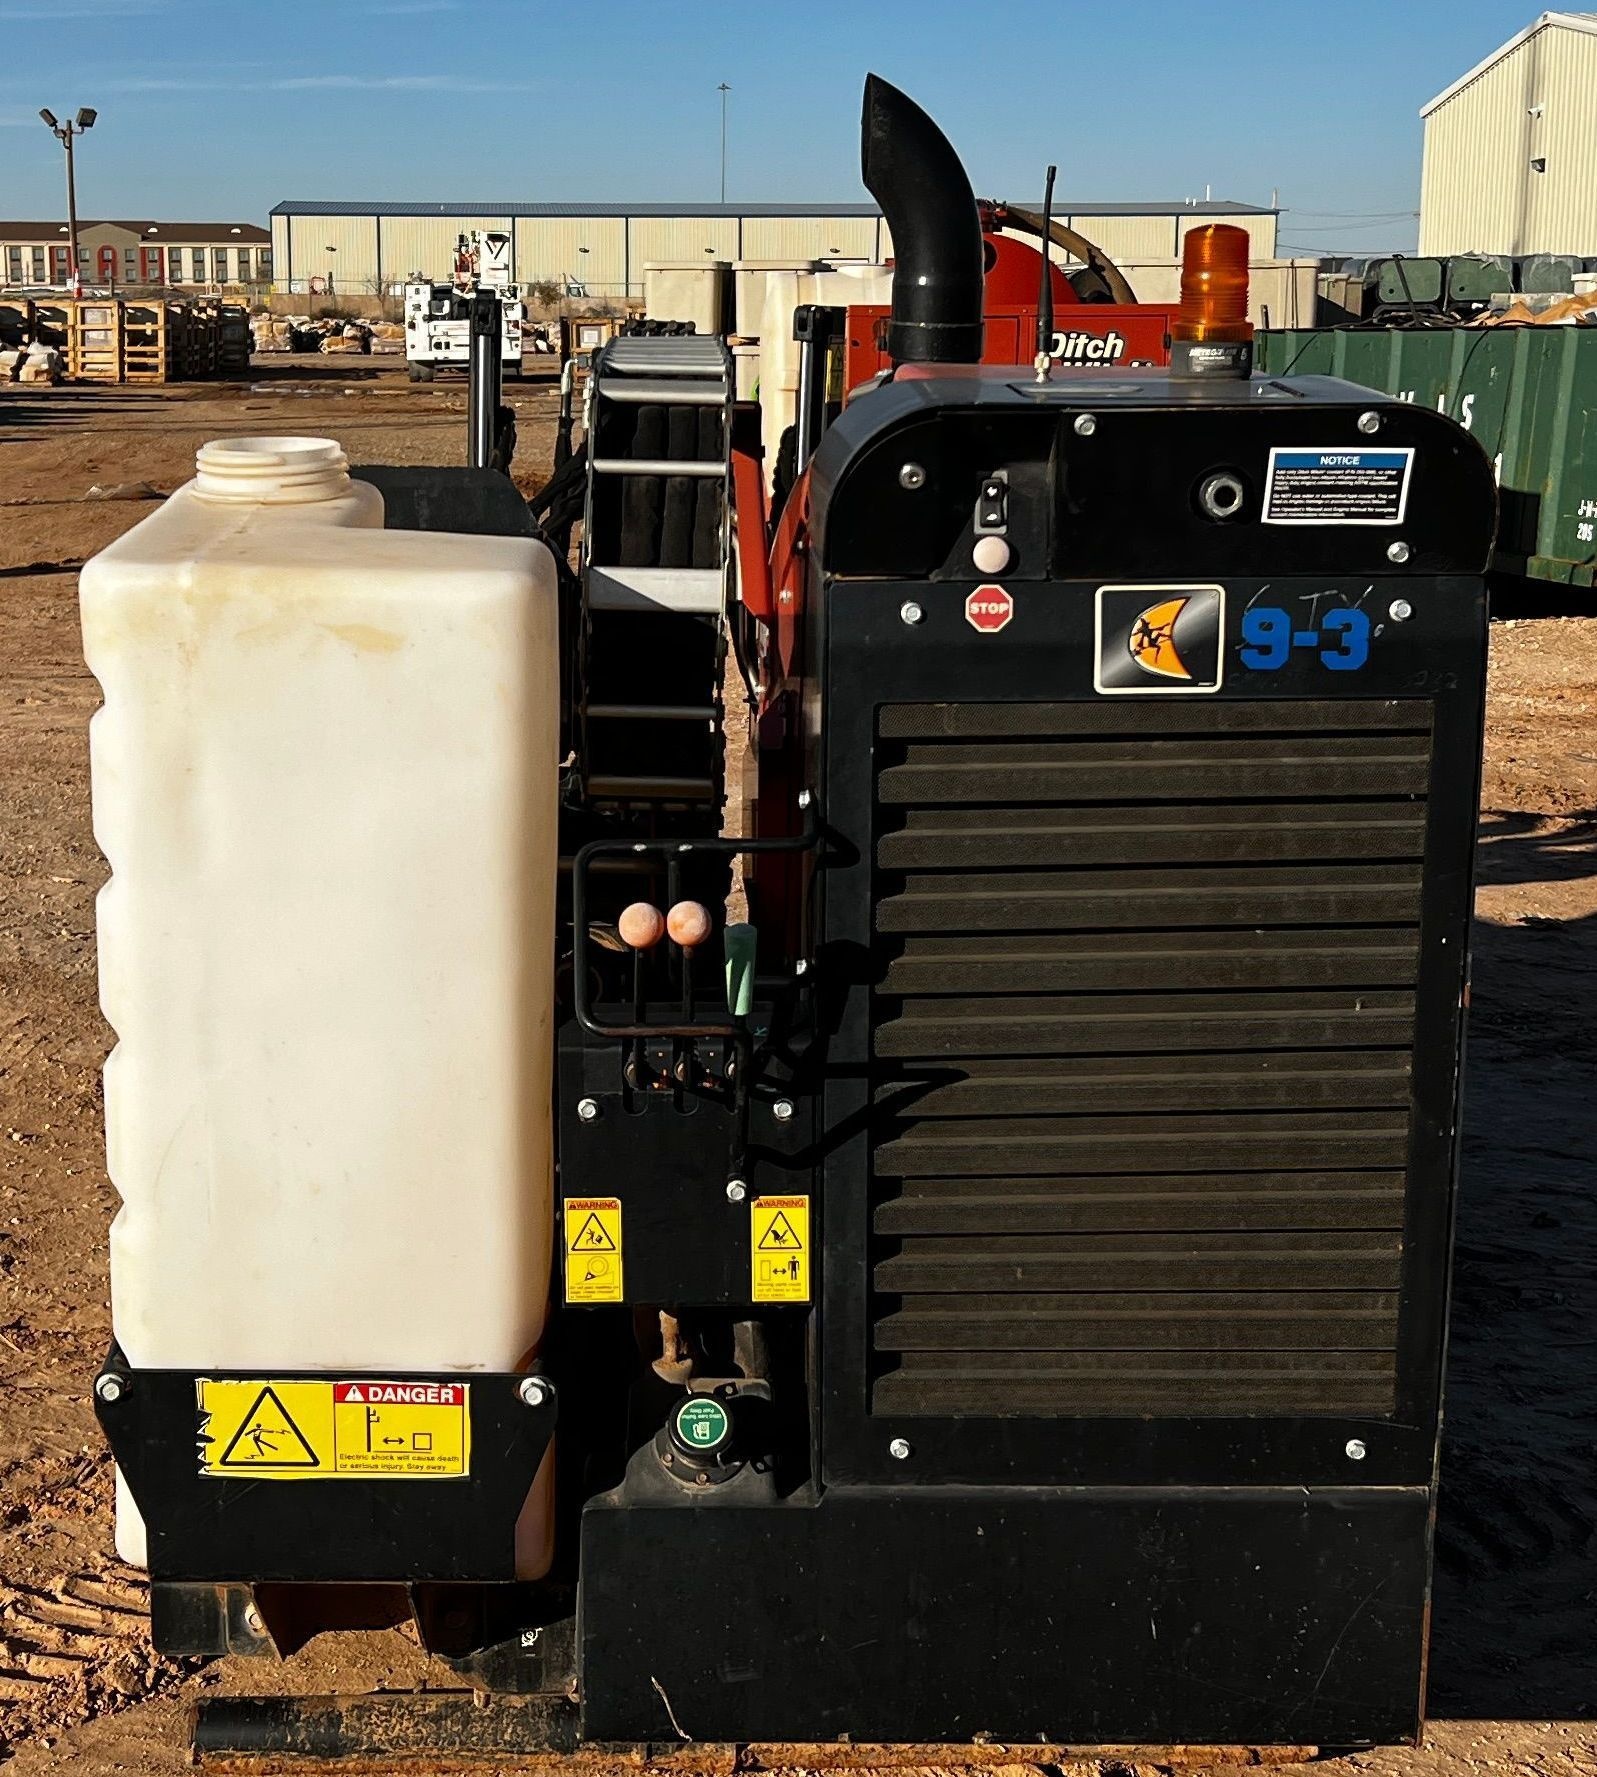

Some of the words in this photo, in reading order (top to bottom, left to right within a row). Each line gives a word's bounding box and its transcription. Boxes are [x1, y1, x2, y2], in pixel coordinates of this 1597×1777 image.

[1050, 332, 1124, 359] Ditch
[1320, 455, 1361, 466] NOTICE
[970, 602, 1010, 615] STOP
[1240, 607, 1371, 670] 9-3
[575, 1200, 619, 1210] WARNING
[762, 1199, 805, 1208] WARNING
[368, 1386, 455, 1403] DANGER
[339, 1453, 369, 1461] Electric
[437, 1455, 460, 1463] death
[407, 1462, 424, 1471] Stay
